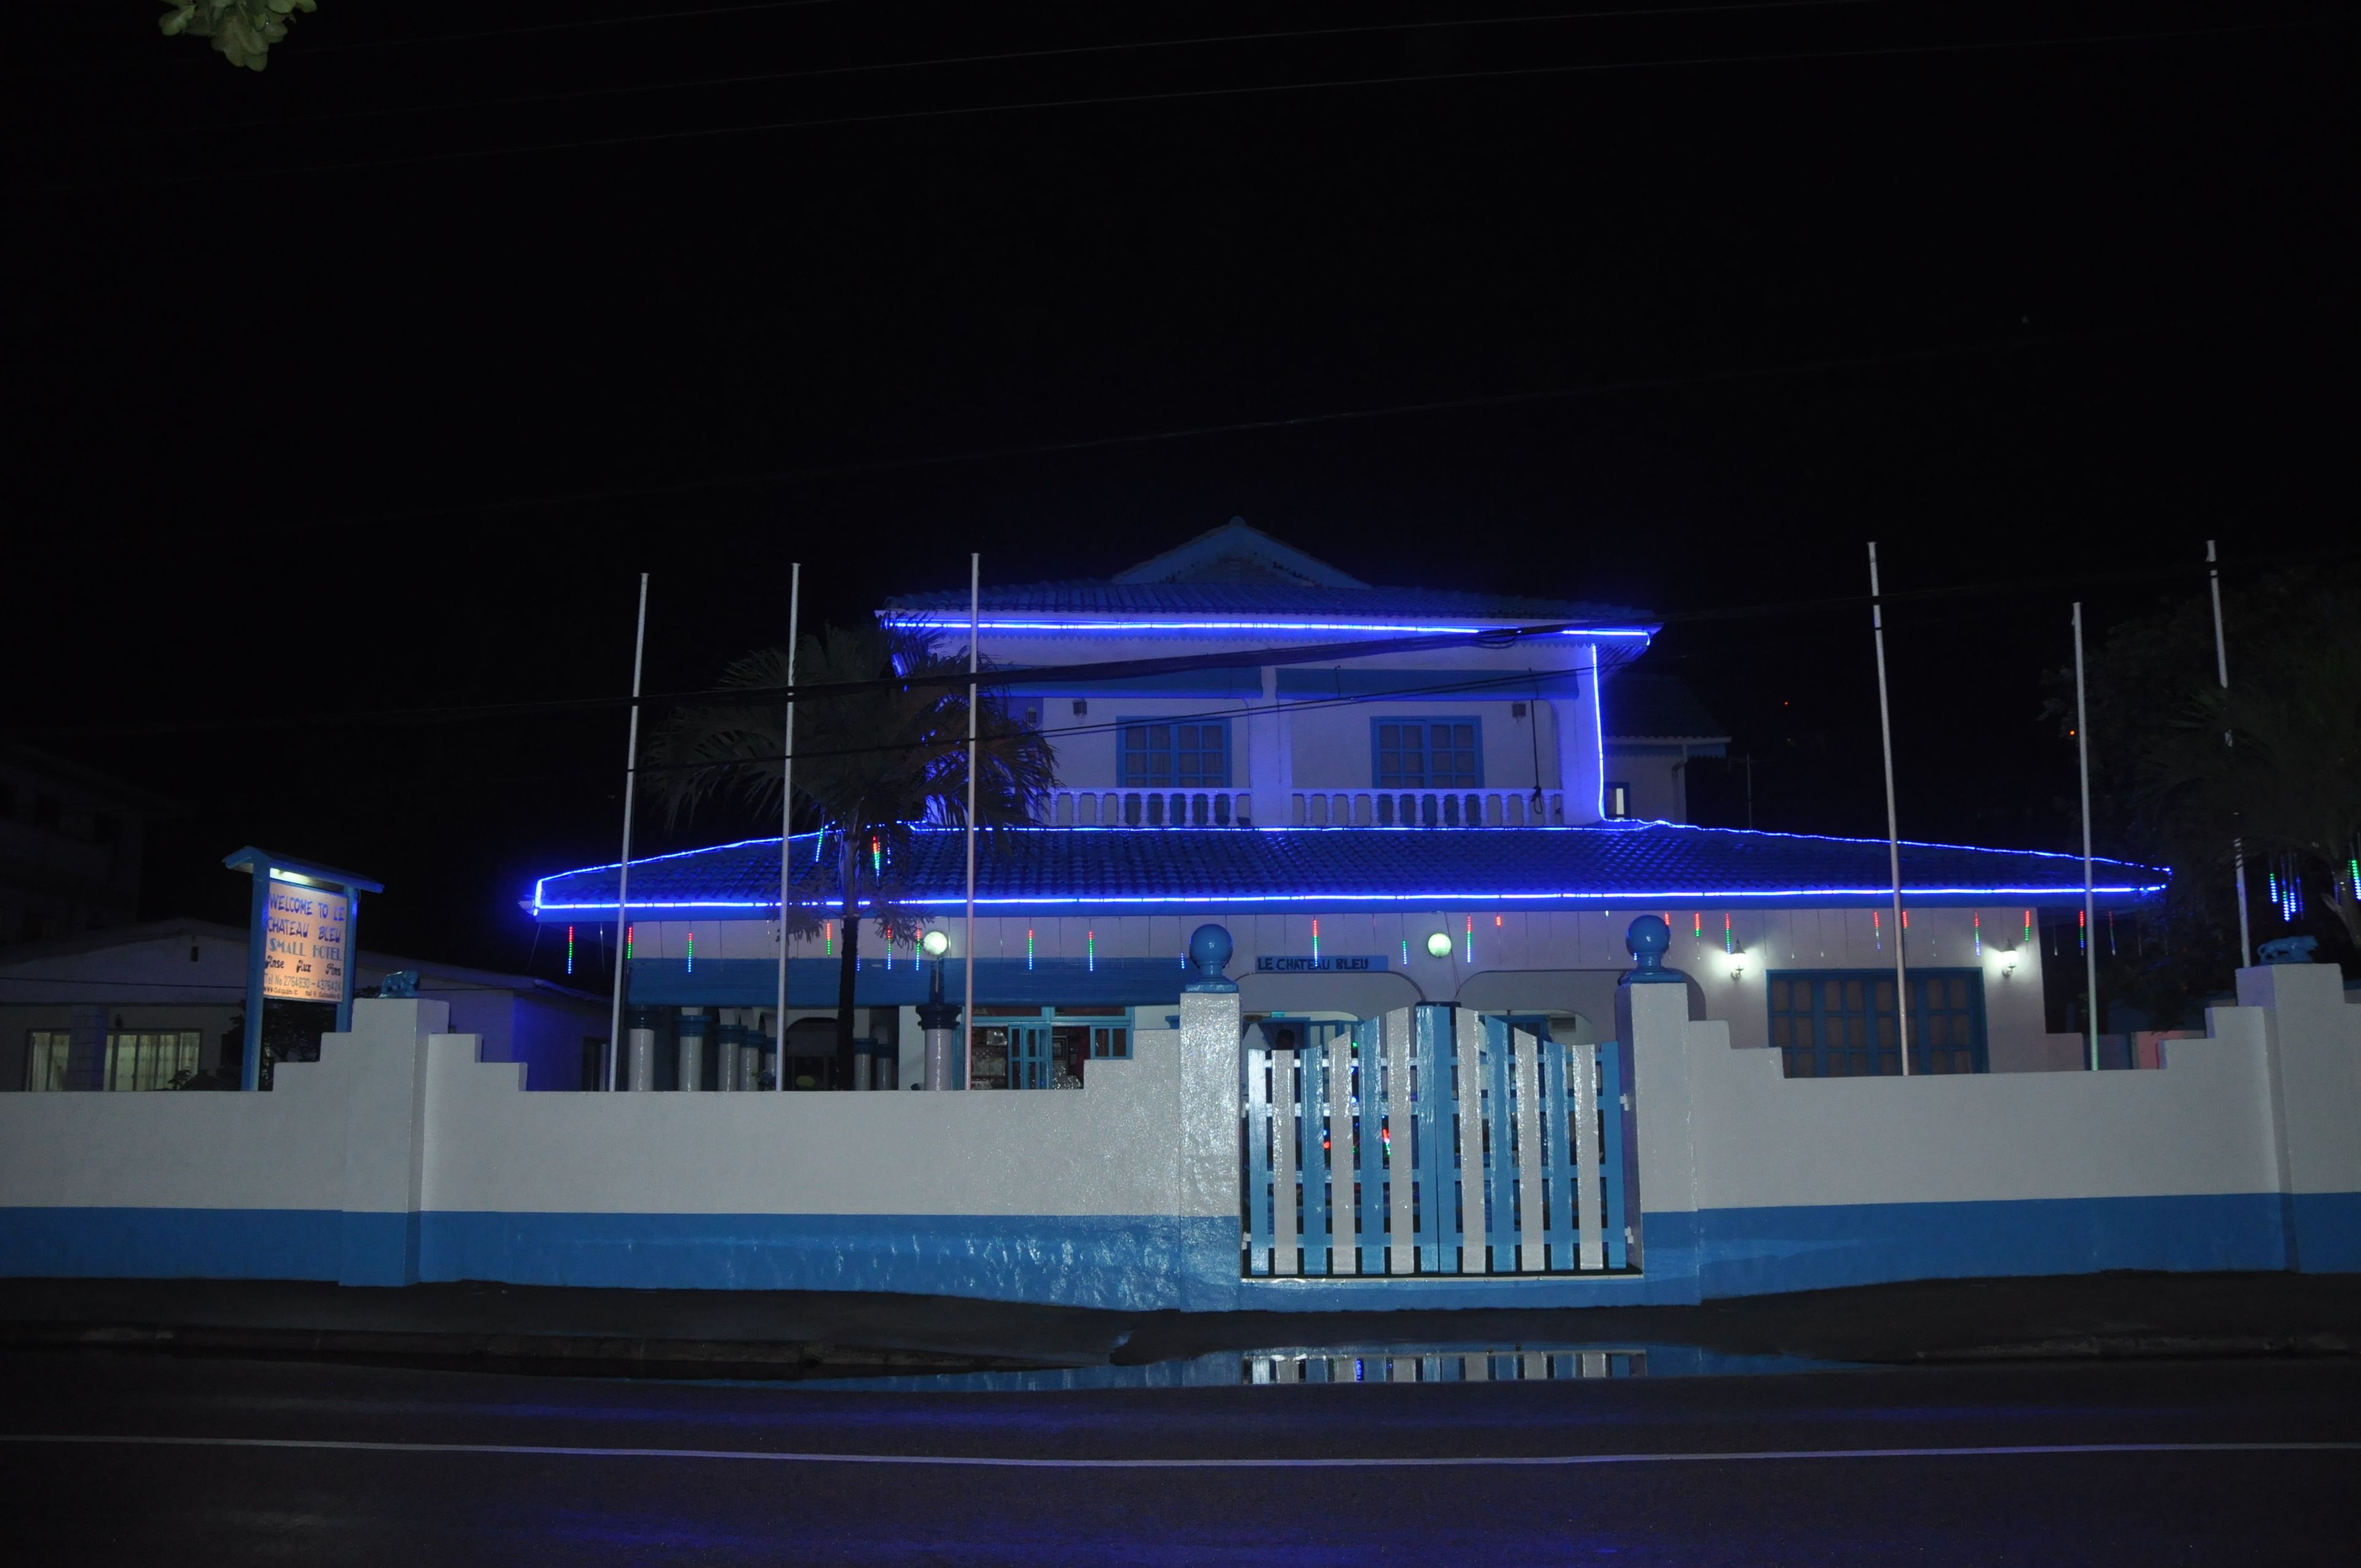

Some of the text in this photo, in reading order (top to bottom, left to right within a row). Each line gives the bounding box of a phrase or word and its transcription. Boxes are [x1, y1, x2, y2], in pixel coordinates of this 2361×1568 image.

[270, 893, 345, 921] WELCOME TO LE
[268, 916, 341, 943] CHATEAU BLEU
[270, 938, 342, 961] SMALL HOTEL
[264, 955, 341, 976] Anse Aux Pins
[1257, 957, 1273, 970] LE
[1336, 958, 1369, 970] BLEU
